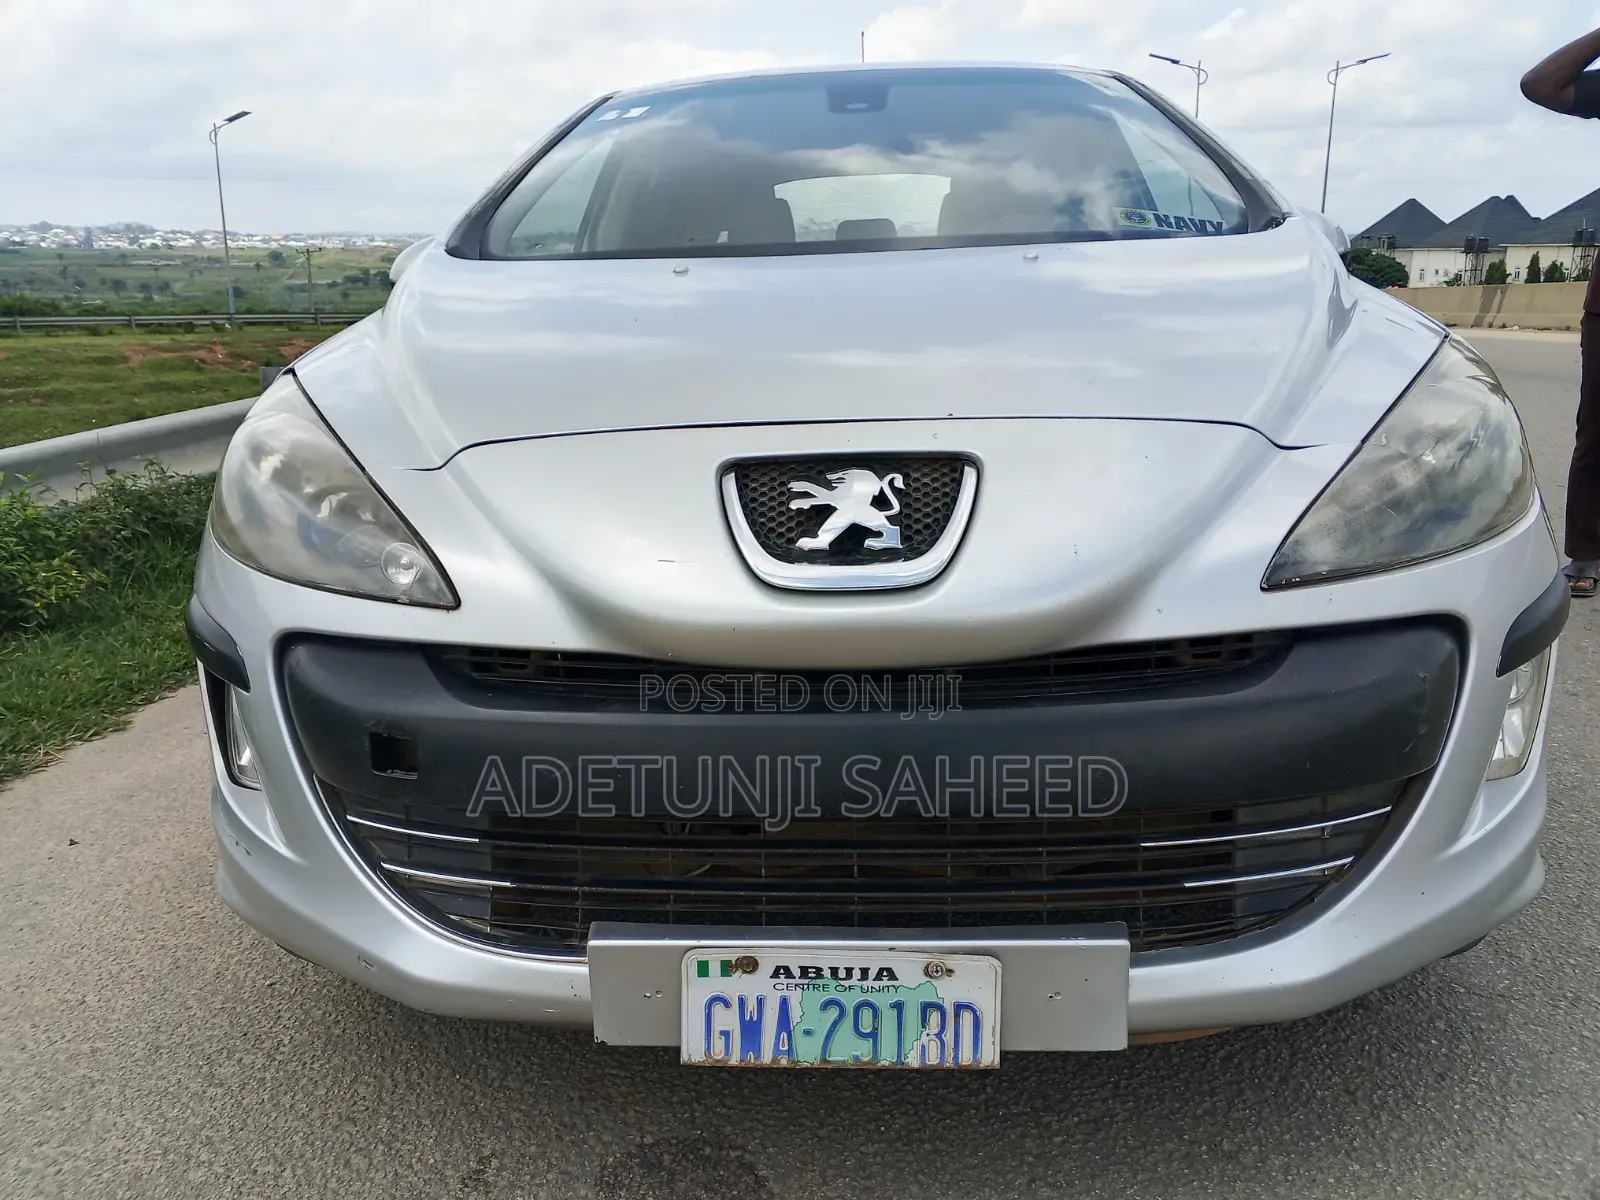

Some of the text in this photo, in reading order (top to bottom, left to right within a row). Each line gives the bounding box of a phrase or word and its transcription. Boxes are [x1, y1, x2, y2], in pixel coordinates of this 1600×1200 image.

[1152, 213, 1223, 234] NAVY
[769, 965, 899, 981] ABUJA
[772, 982, 902, 994] CENTRE OF UNITY
